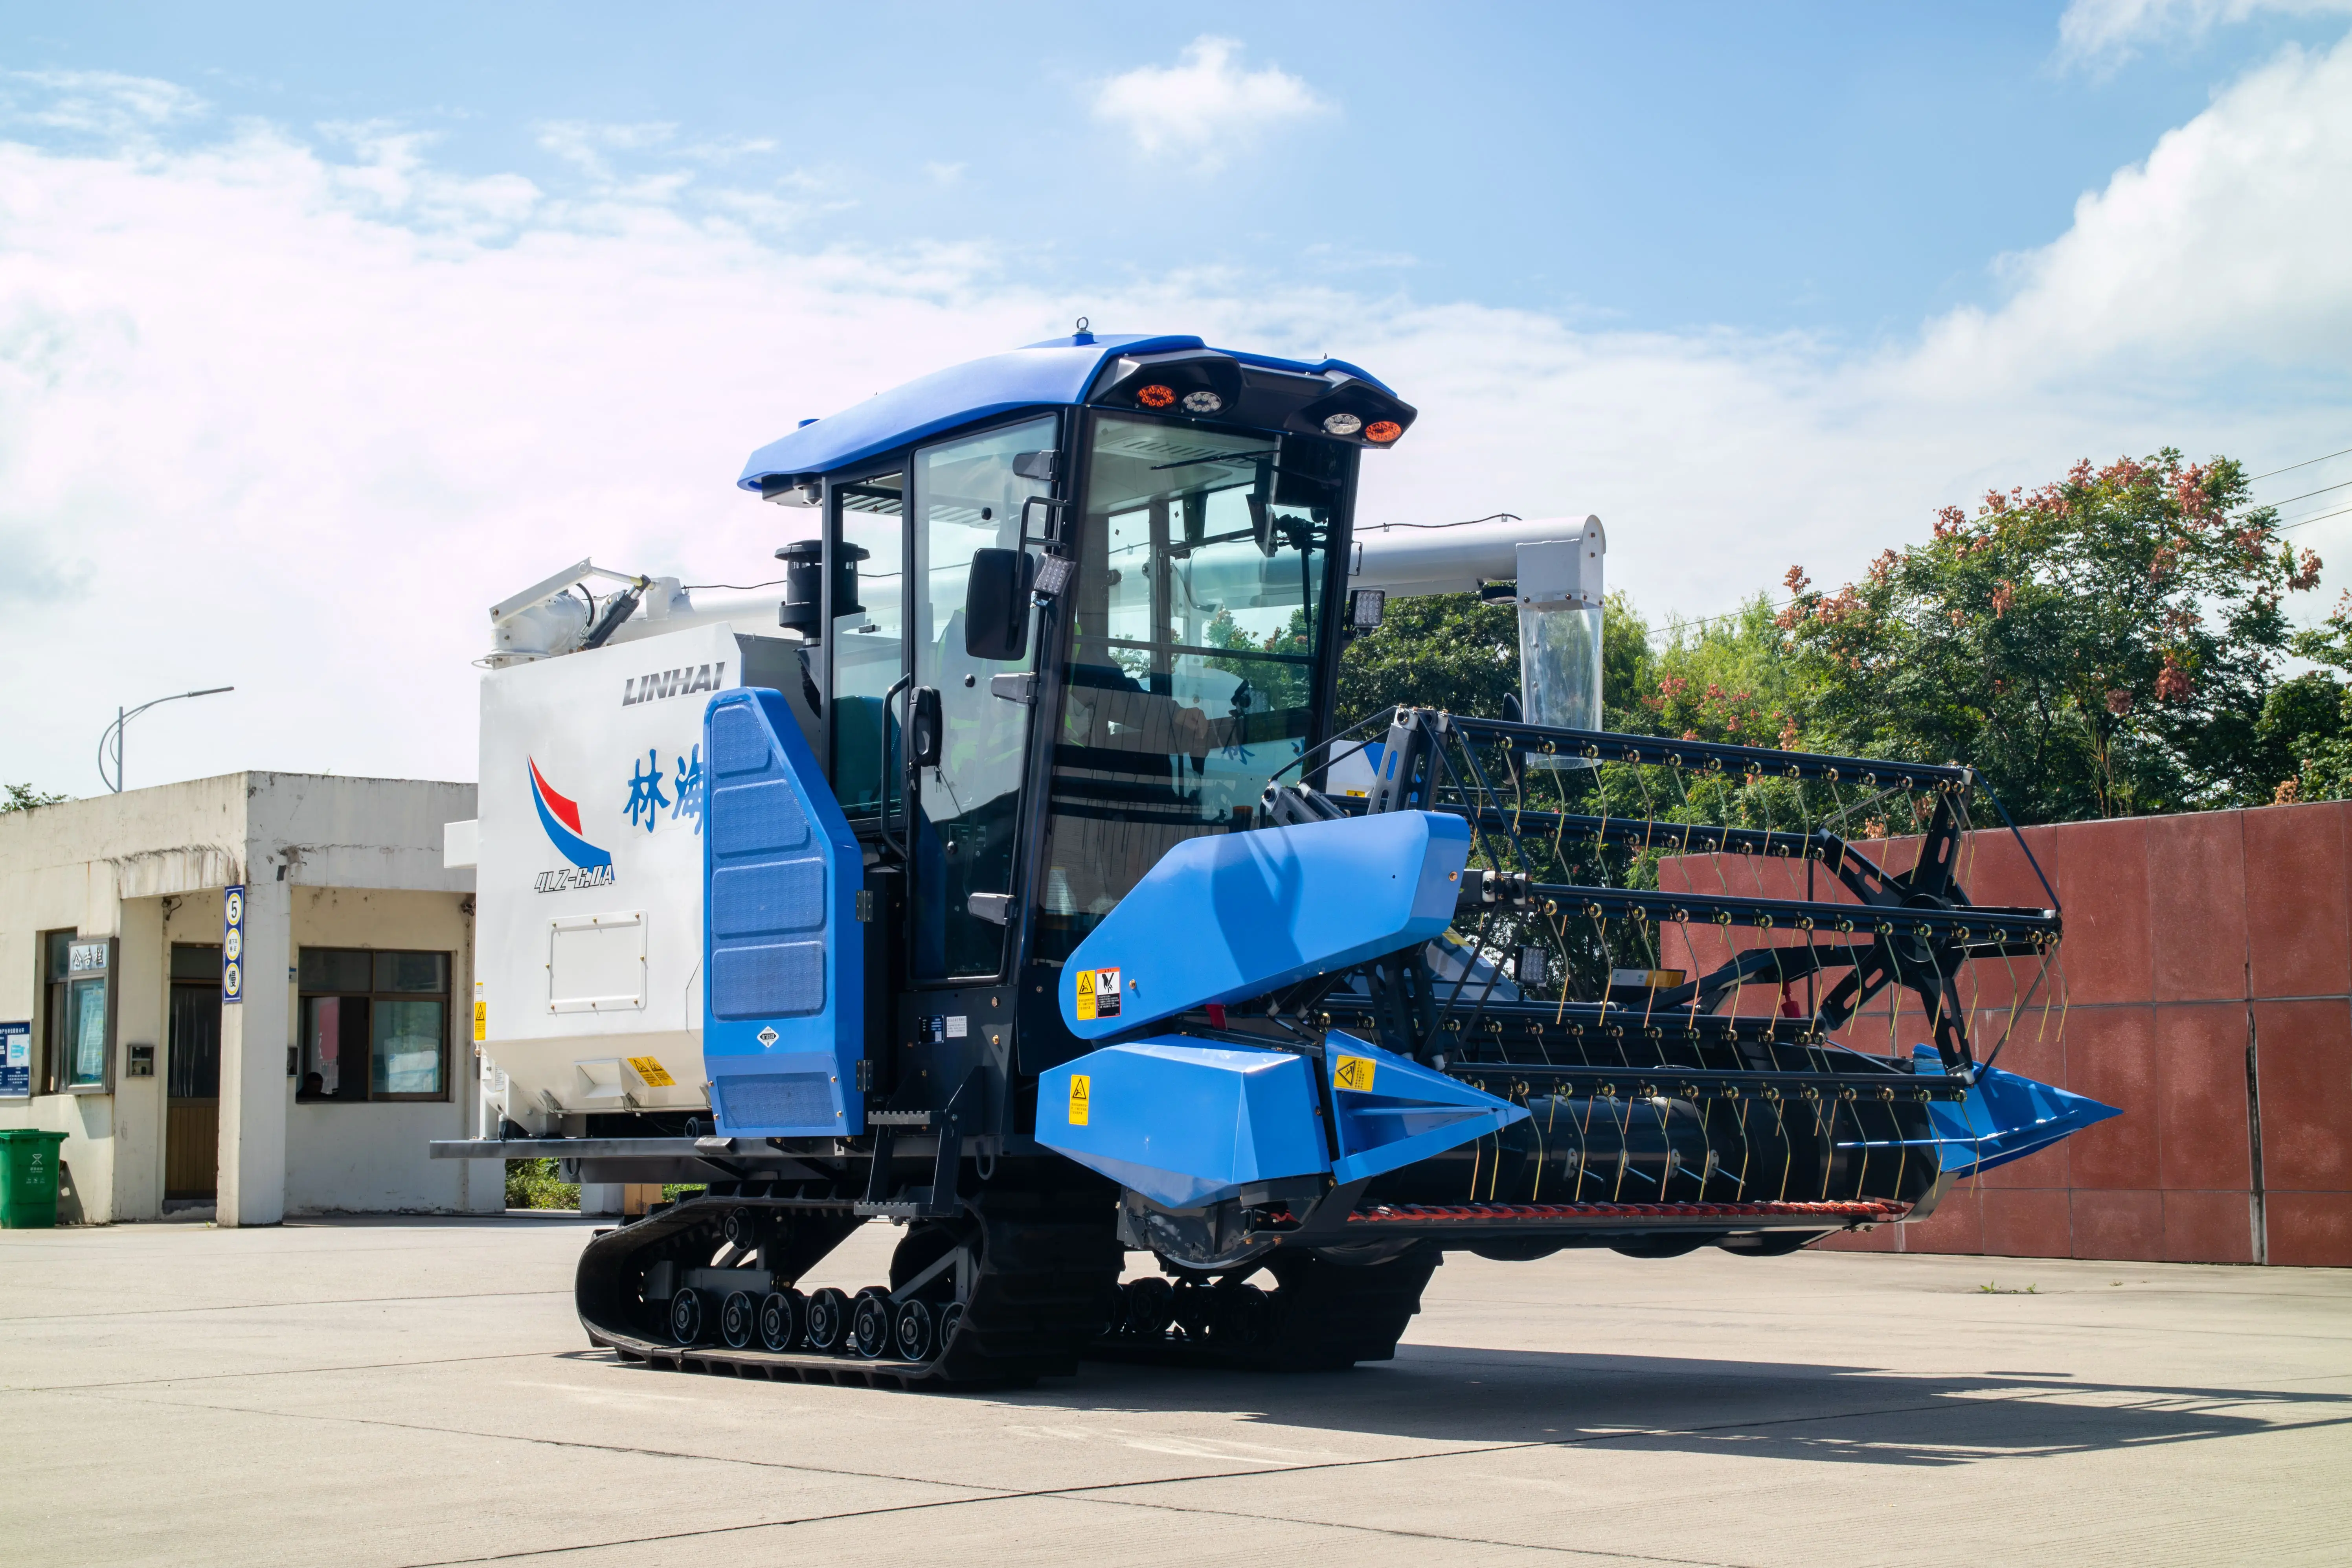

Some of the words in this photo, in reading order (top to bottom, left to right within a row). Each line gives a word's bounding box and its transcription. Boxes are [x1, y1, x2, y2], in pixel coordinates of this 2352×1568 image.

[622, 662, 725, 706] LINHAI
[534, 864, 612, 893] 4LZ-6.0A
[231, 901, 237, 918] 5
[72, 946, 103, 966] 公告栏
[229, 971, 236, 987] 慢
